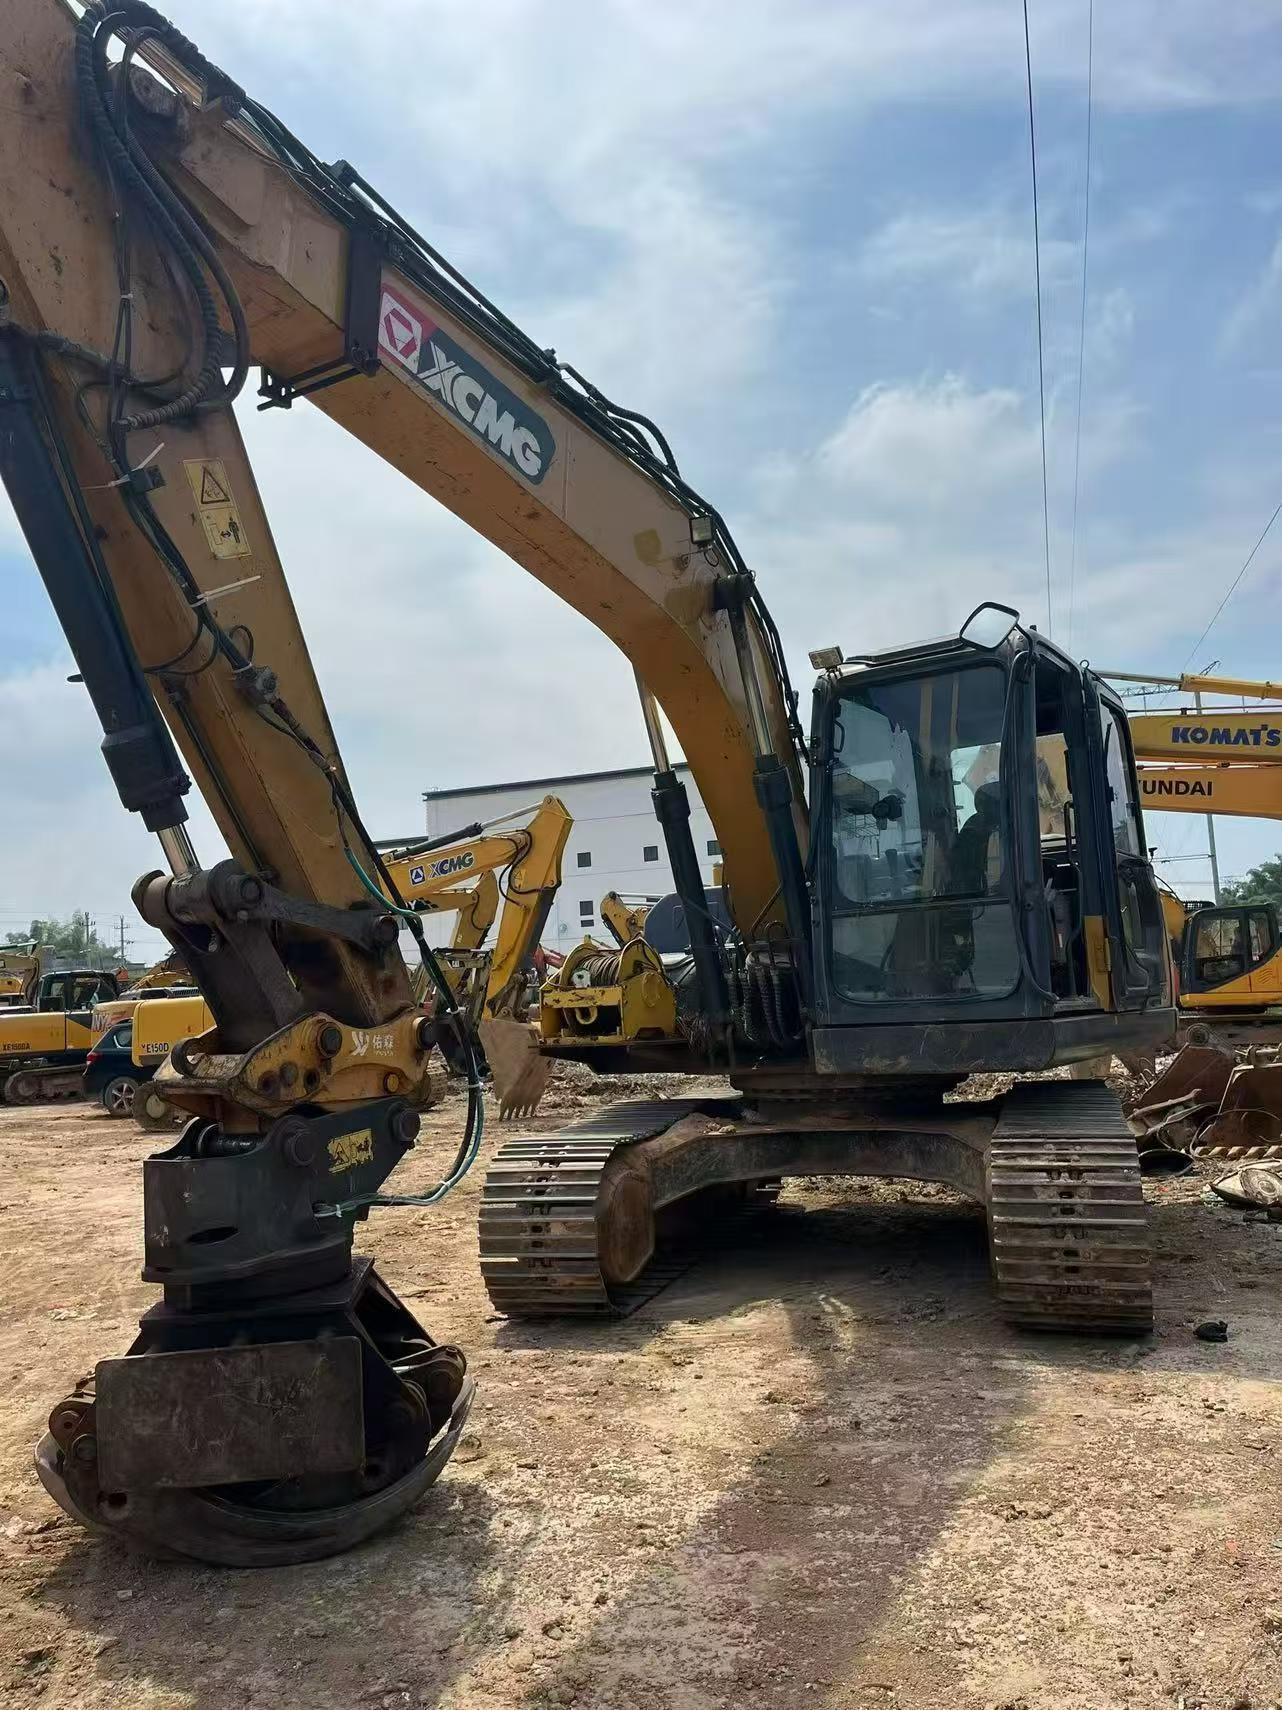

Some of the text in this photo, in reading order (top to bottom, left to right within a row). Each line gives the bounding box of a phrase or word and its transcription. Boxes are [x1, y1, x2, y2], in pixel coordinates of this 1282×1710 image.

[416, 340, 542, 476] XCMG
[1138, 779, 1213, 796] UNDAI
[428, 851, 474, 879] XCMG
